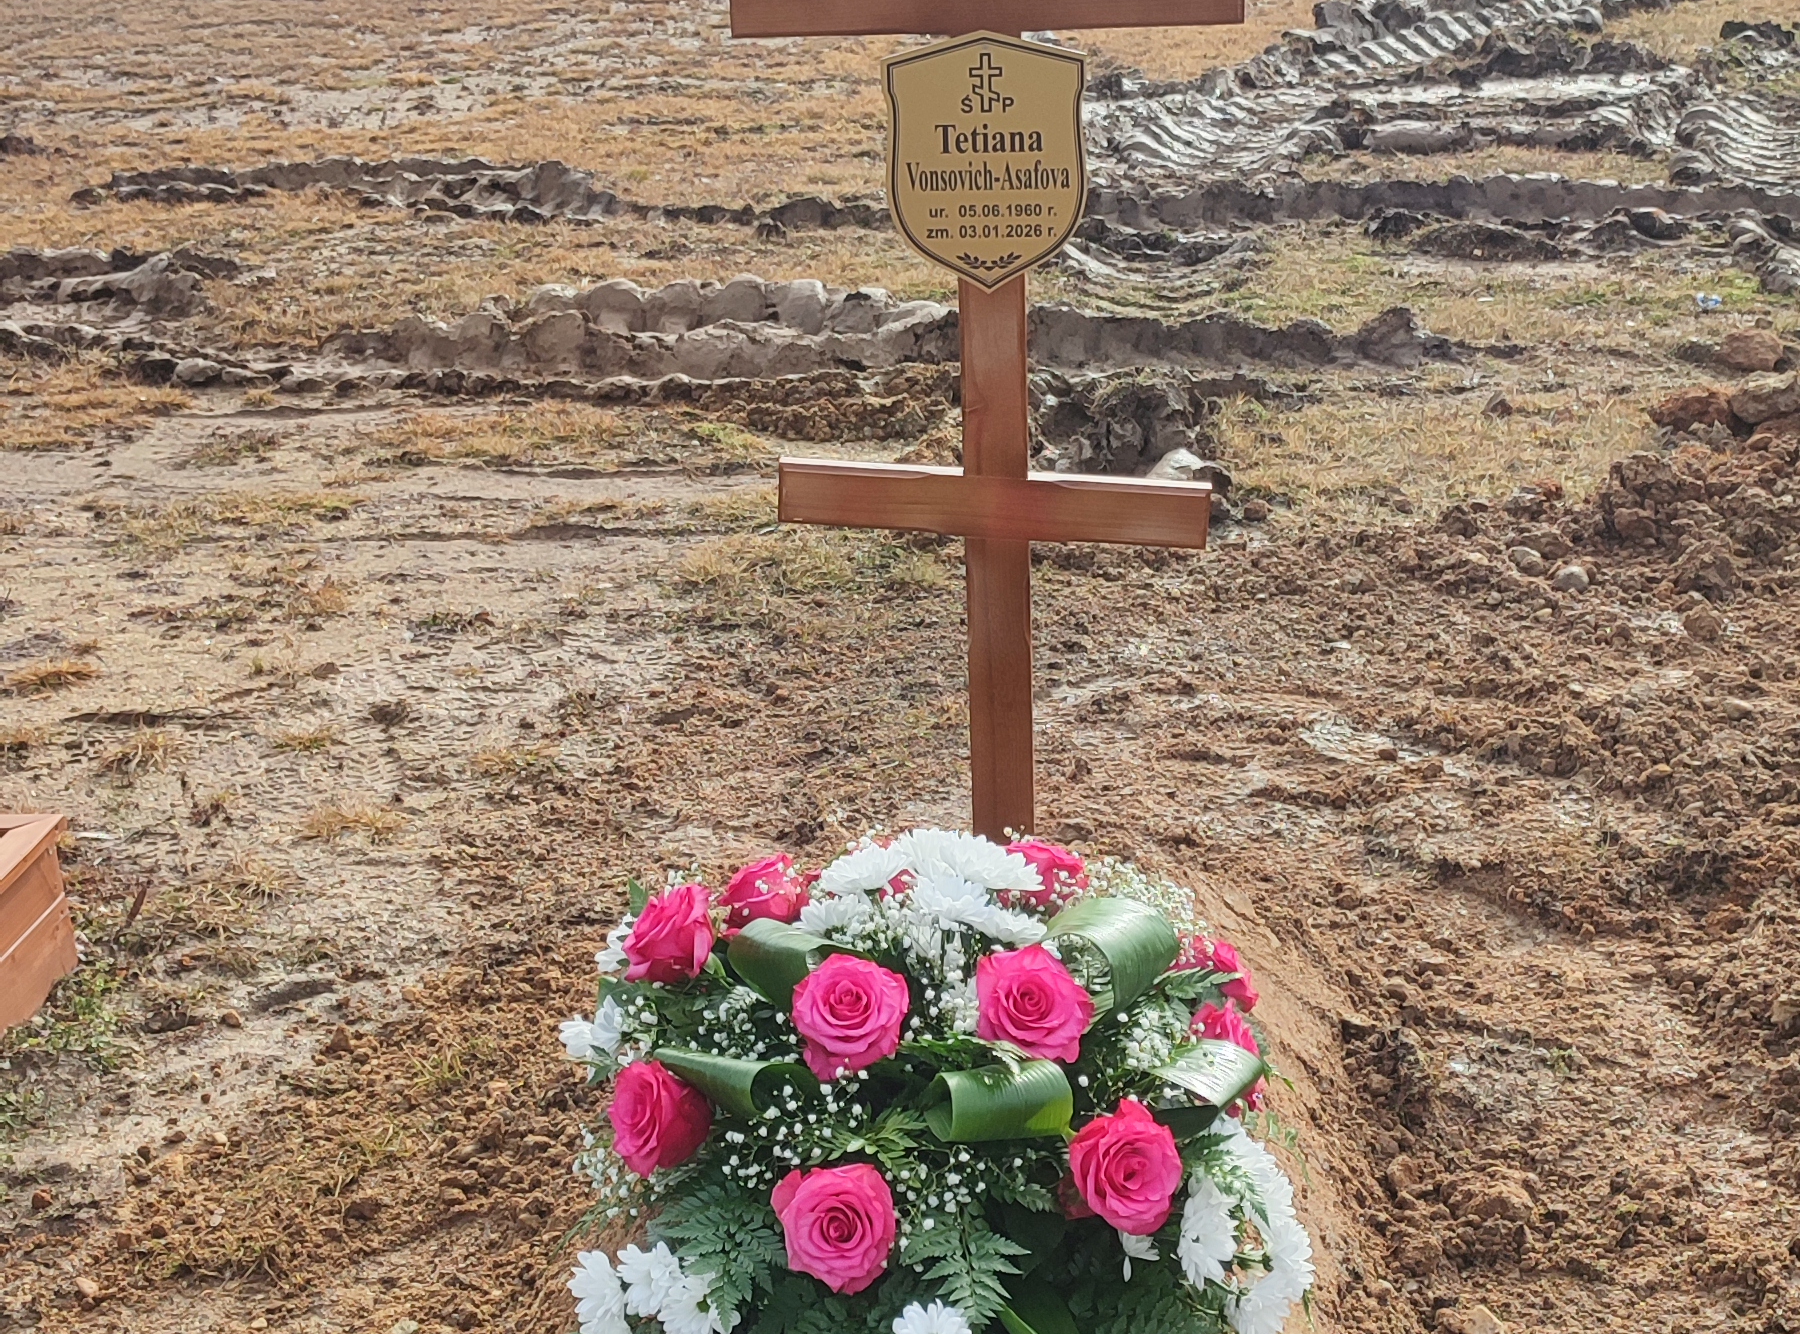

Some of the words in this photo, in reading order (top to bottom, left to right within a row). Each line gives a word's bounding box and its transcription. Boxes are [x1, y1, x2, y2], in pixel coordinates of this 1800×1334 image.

[960, 94, 973, 114] Ś
[1002, 97, 1015, 113] P
[934, 123, 1043, 154] Tetiana
[906, 160, 1070, 192] Vonsovich-Asafova
[929, 206, 949, 218] ur.
[958, 204, 1043, 218] 05.06.1960
[1047, 205, 1057, 217] r.
[926, 227, 954, 239] zm.
[959, 224, 1043, 239] 03.01.2026
[1047, 226, 1057, 238] r.
